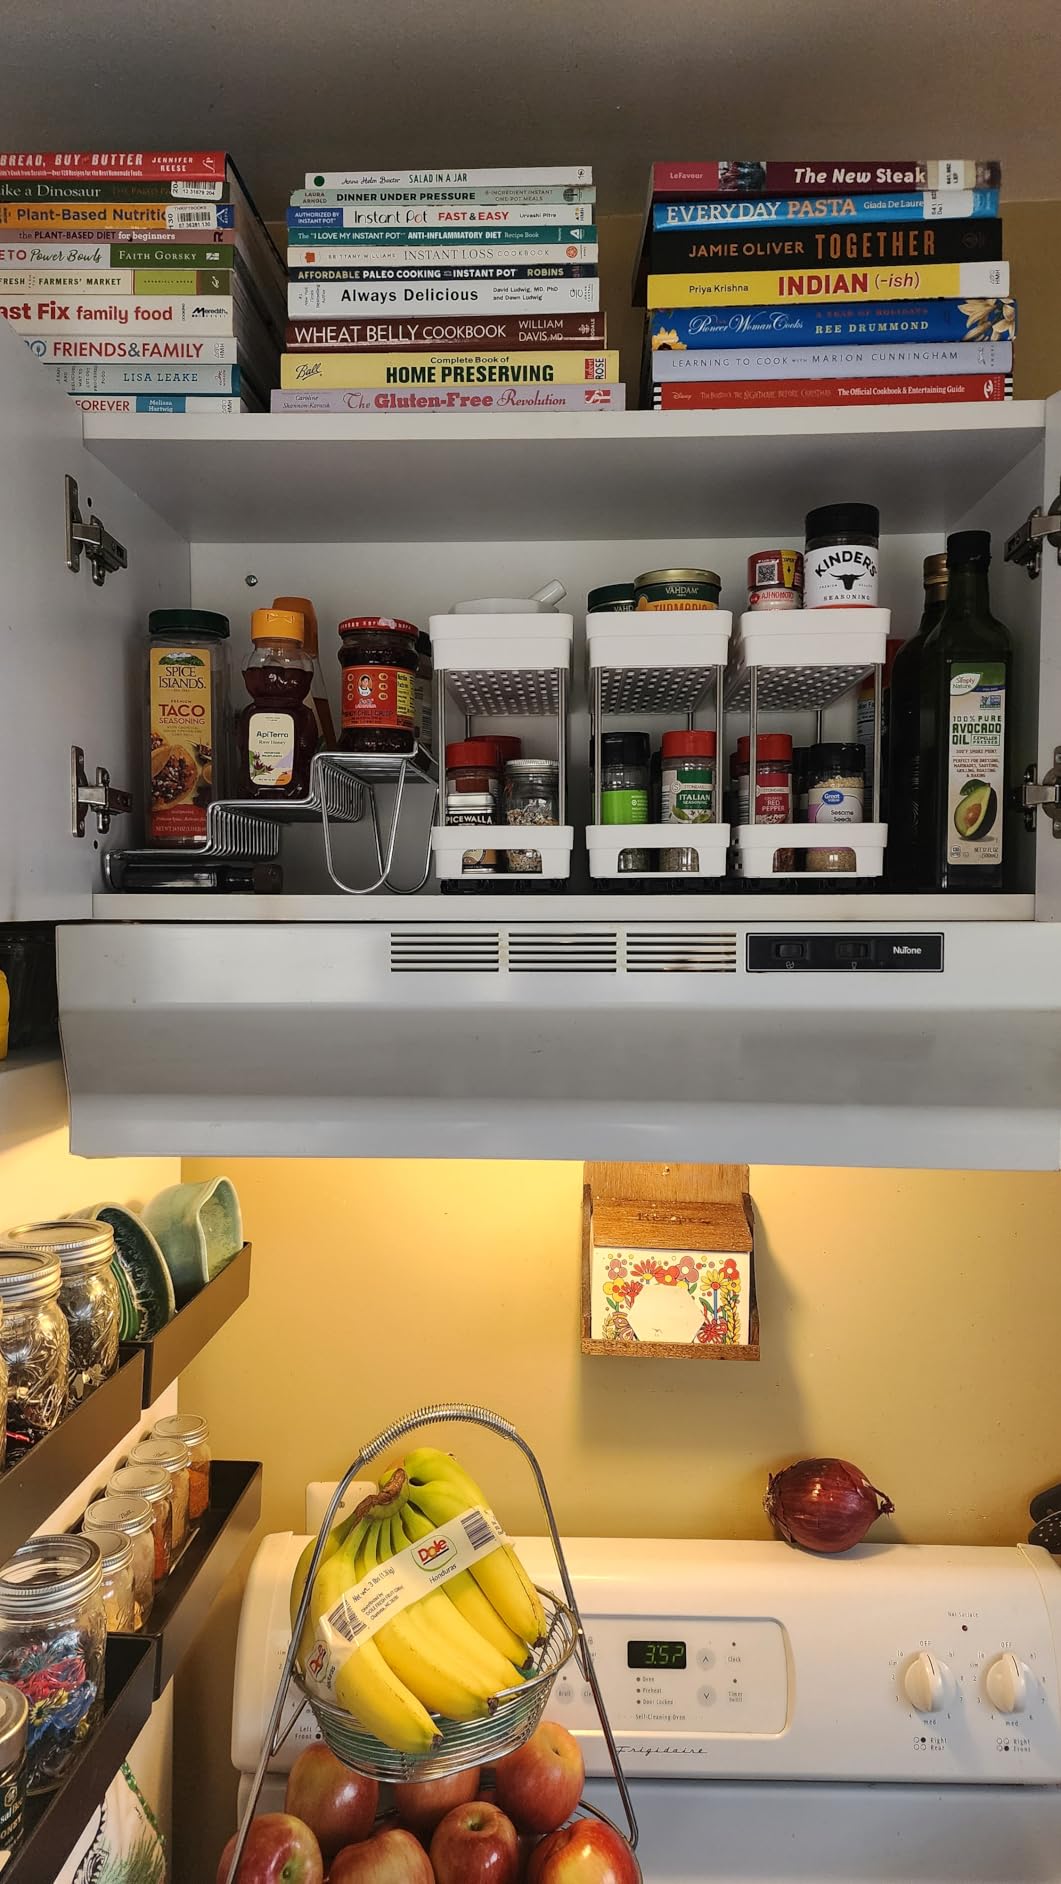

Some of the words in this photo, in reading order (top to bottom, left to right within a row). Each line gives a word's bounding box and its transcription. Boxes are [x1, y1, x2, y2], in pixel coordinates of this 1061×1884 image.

[0, 154, 46, 166] BREAD,
[54, 154, 80, 166] BUY
[92, 154, 143, 166] BUTTER
[409, 174, 433, 184] SALAD
[436, 174, 443, 182] IN
[446, 174, 451, 182] A
[454, 173, 467, 182] JAR
[794, 168, 827, 184] The
[832, 168, 871, 184] New
[876, 167, 926, 184] Steak
[37, 184, 102, 197] Dinosaur
[336, 194, 377, 202] DINNER
[421, 192, 476, 201] PRESSURE
[17, 208, 106, 220] Plant-Based
[354, 211, 400, 224] Instant
[406, 210, 428, 223] Pot
[438, 212, 467, 221] FAST
[478, 212, 509, 220] EASY
[666, 202, 781, 224] EVERYDAY
[788, 198, 856, 218] PASTA
[864, 201, 887, 209] Giada
[19, 231, 32, 239] the
[34, 231, 94, 239] PLANT-BASED
[96, 231, 116, 239] DIET
[118, 232, 131, 240] for
[132, 232, 175, 241] beginners
[689, 244, 739, 258] JAMIE
[743, 242, 804, 255] OLIVER
[815, 230, 935, 259] TOGETHER
[0, 250, 27, 260] ETO
[30, 248, 65, 262] Power
[66, 248, 102, 263] Bowls
[120, 251, 150, 260] FAITH
[155, 250, 197, 260] GORSKY
[404, 250, 458, 260] INSTANT
[462, 249, 494, 259] LOSS
[298, 271, 360, 280] AFFORDABLE
[363, 270, 394, 279] PALEO
[397, 270, 441, 278] COOKING
[453, 269, 494, 278] INSTANT
[527, 268, 564, 277] ROBINS
[689, 286, 712, 295] Priya
[714, 284, 749, 292] Krishna
[778, 273, 868, 296] INDIAN
[874, 272, 920, 289] (-ish)
[341, 289, 397, 304] Always
[404, 288, 478, 301] Delicious
[0, 303, 31, 320] ast
[38, 300, 70, 320] Fix
[76, 306, 128, 324] family
[134, 306, 173, 320] food
[519, 320, 563, 329] WILLIAM
[729, 311, 772, 333] Woman
[769, 312, 803, 329] Cooks
[816, 325, 841, 334] REE
[849, 322, 929, 332] DRUMMOND
[295, 326, 361, 343] WHEAT
[367, 325, 419, 341] BELLY
[423, 325, 506, 339] COOKBOOK
[672, 359, 729, 368] LEARNING
[812, 354, 863, 363] MARION
[871, 352, 959, 361] CUNNINGHAM
[296, 363, 322, 380] Ball
[386, 366, 436, 383] HOME
[442, 365, 554, 382] PRESERVING
[595, 358, 604, 379] ROSE
[124, 373, 152, 382] LISA
[157, 373, 198, 382] LEAKE
[672, 392, 692, 400] Disney
[838, 388, 850, 396] The
[850, 388, 872, 396] Official
[908, 386, 946, 395] Entertaining
[343, 392, 370, 409] The
[374, 392, 494, 409] Gluten-Free
[497, 388, 566, 407] Revolution
[166, 666, 196, 676] SPICE
[159, 704, 205, 717] TACO
[952, 723, 1002, 733] AVOCADO
[952, 735, 969, 745] OIL
[446, 815, 492, 824] PICEWALLA
[893, 946, 922, 954] NuTone
[417, 1538, 449, 1563] Dole
[428, 1564, 457, 1584] Honduras
[616, 1746, 708, 1756] Frigidaire
